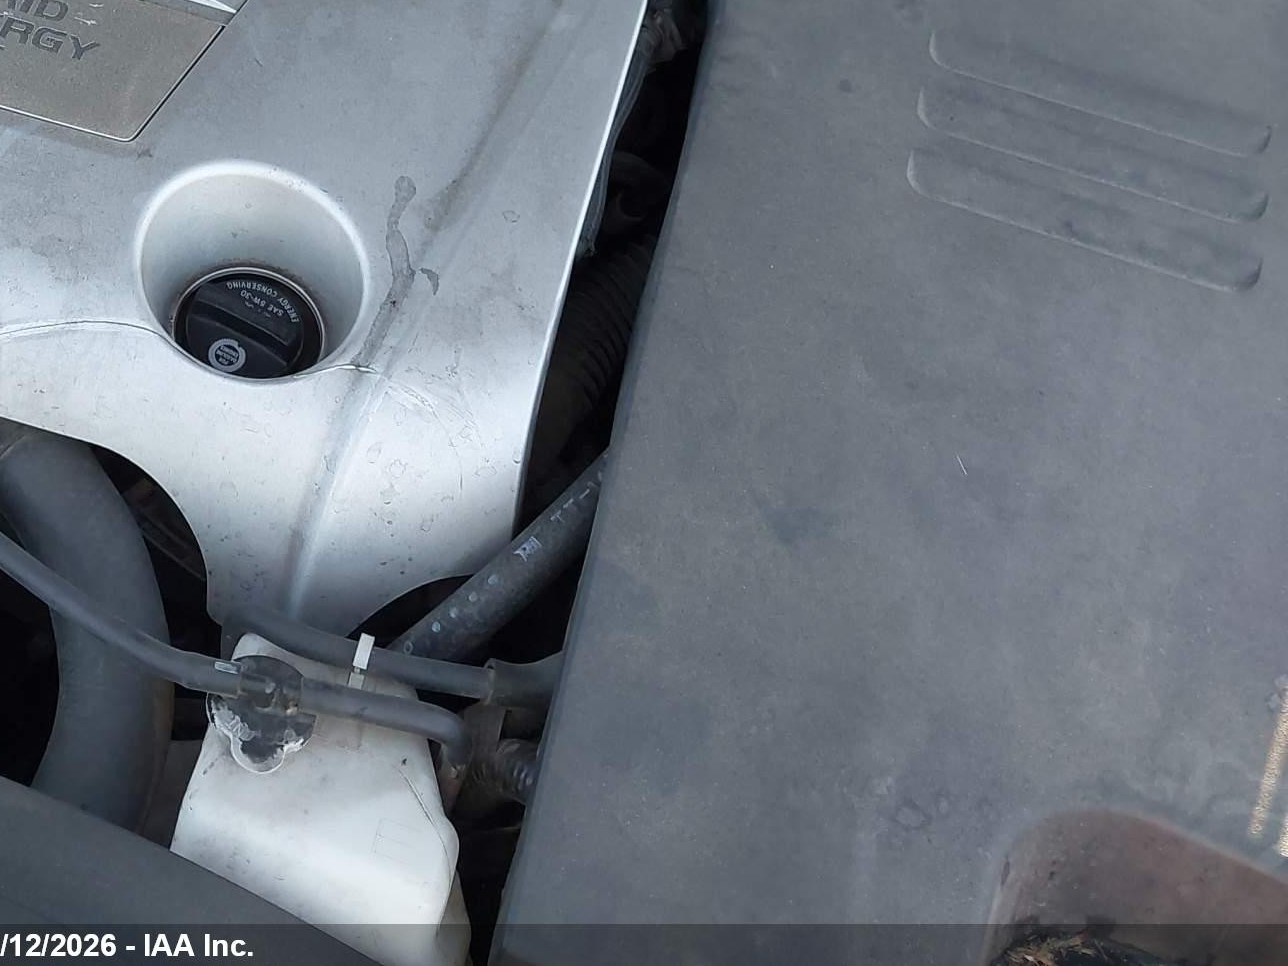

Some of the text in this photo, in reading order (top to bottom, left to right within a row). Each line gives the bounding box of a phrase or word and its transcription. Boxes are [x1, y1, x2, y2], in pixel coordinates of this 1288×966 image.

[226, 281, 279, 297] CONSERVING
[267, 303, 285, 317] SAE
[277, 297, 300, 323] ENERGY
